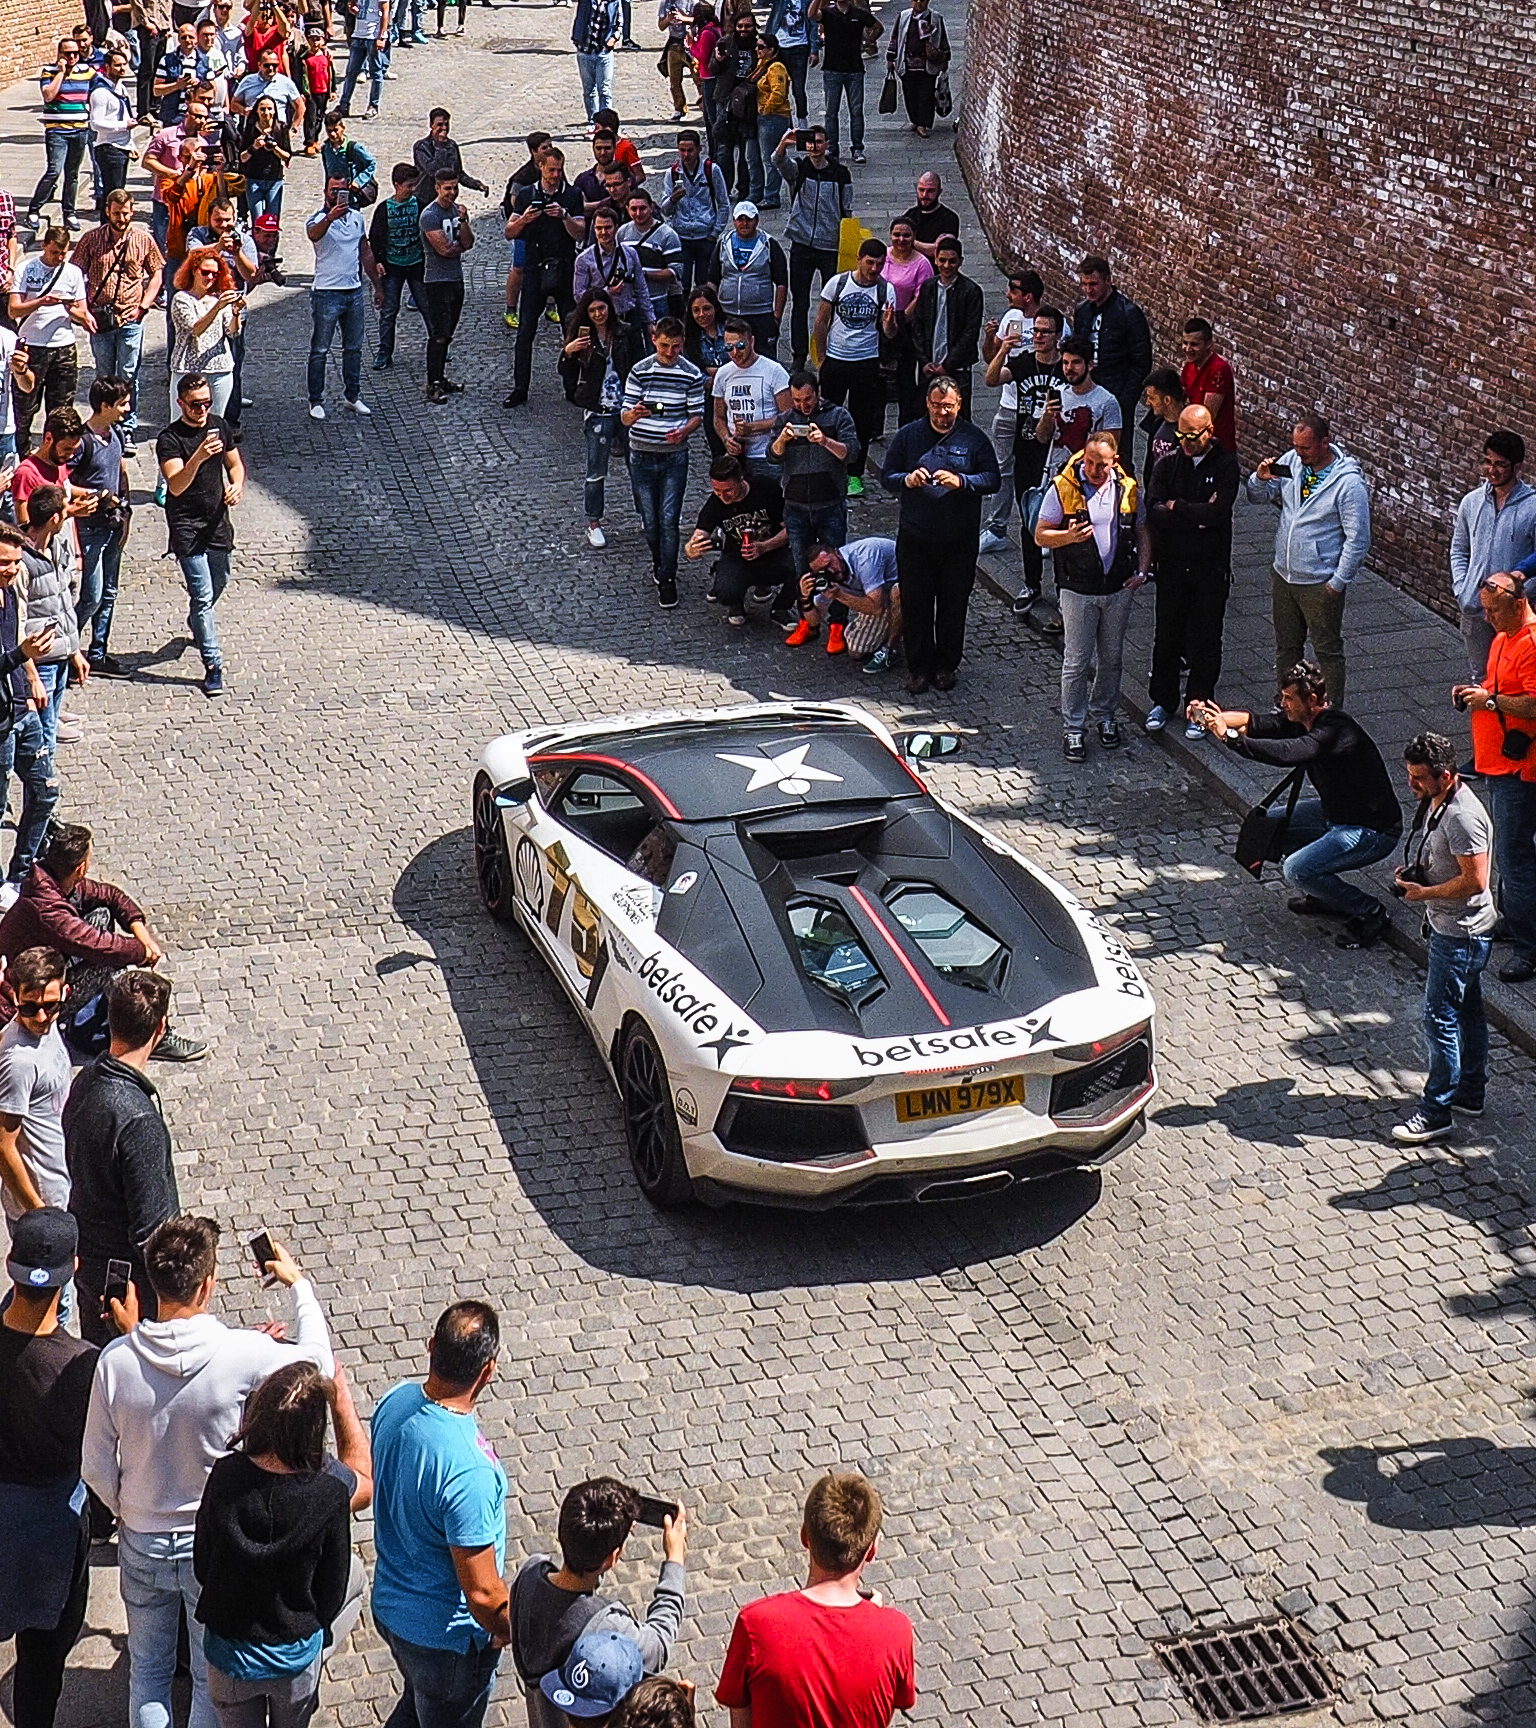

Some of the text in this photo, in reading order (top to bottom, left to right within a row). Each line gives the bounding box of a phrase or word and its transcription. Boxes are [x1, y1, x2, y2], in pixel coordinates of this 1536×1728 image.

[638, 950, 719, 1035] betsafe
[852, 1024, 1017, 1066] betsafe
[905, 1078, 1017, 1118] LMN 979X
